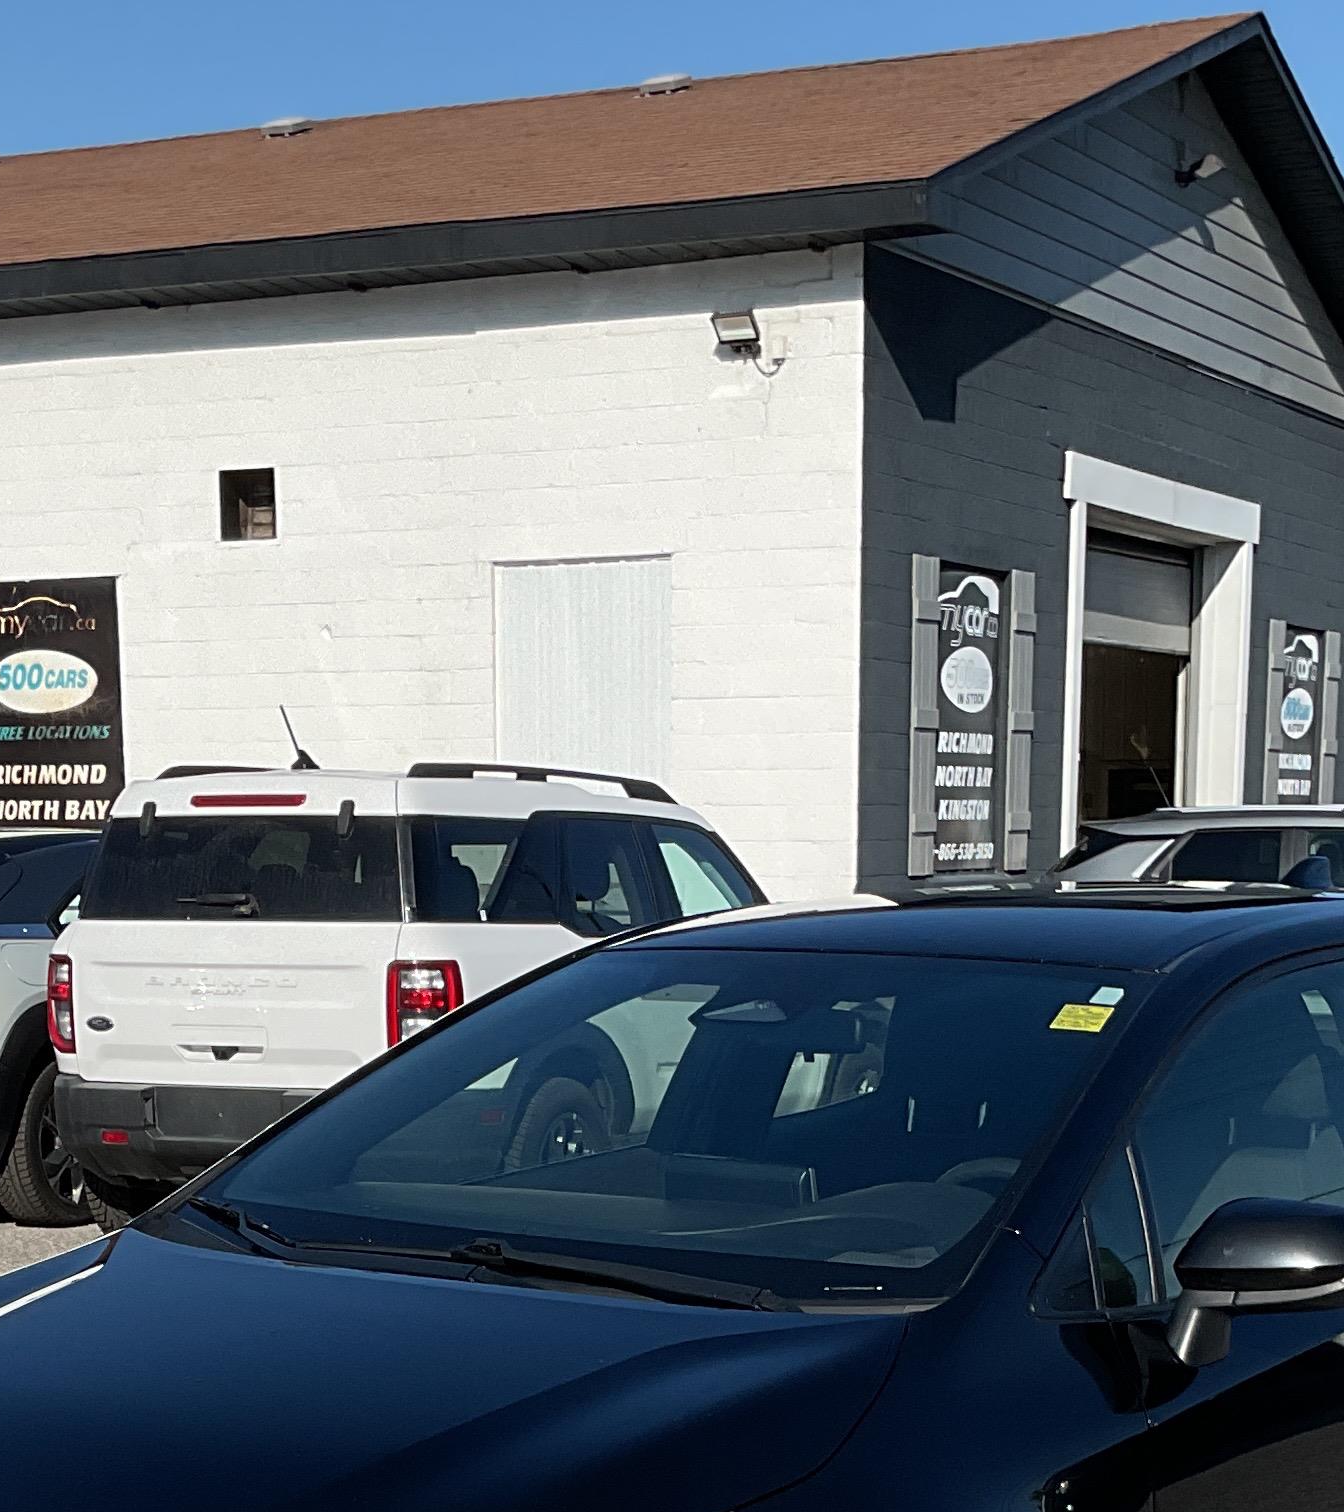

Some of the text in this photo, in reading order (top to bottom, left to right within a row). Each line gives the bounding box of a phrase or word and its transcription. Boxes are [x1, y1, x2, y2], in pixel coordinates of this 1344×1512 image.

[27, 725, 111, 740] LOCATIONS
[937, 731, 994, 754] RICHMOND
[935, 765, 993, 787] NORTH BAY
[64, 799, 111, 821] BAY
[938, 799, 990, 821] KINGSTON
